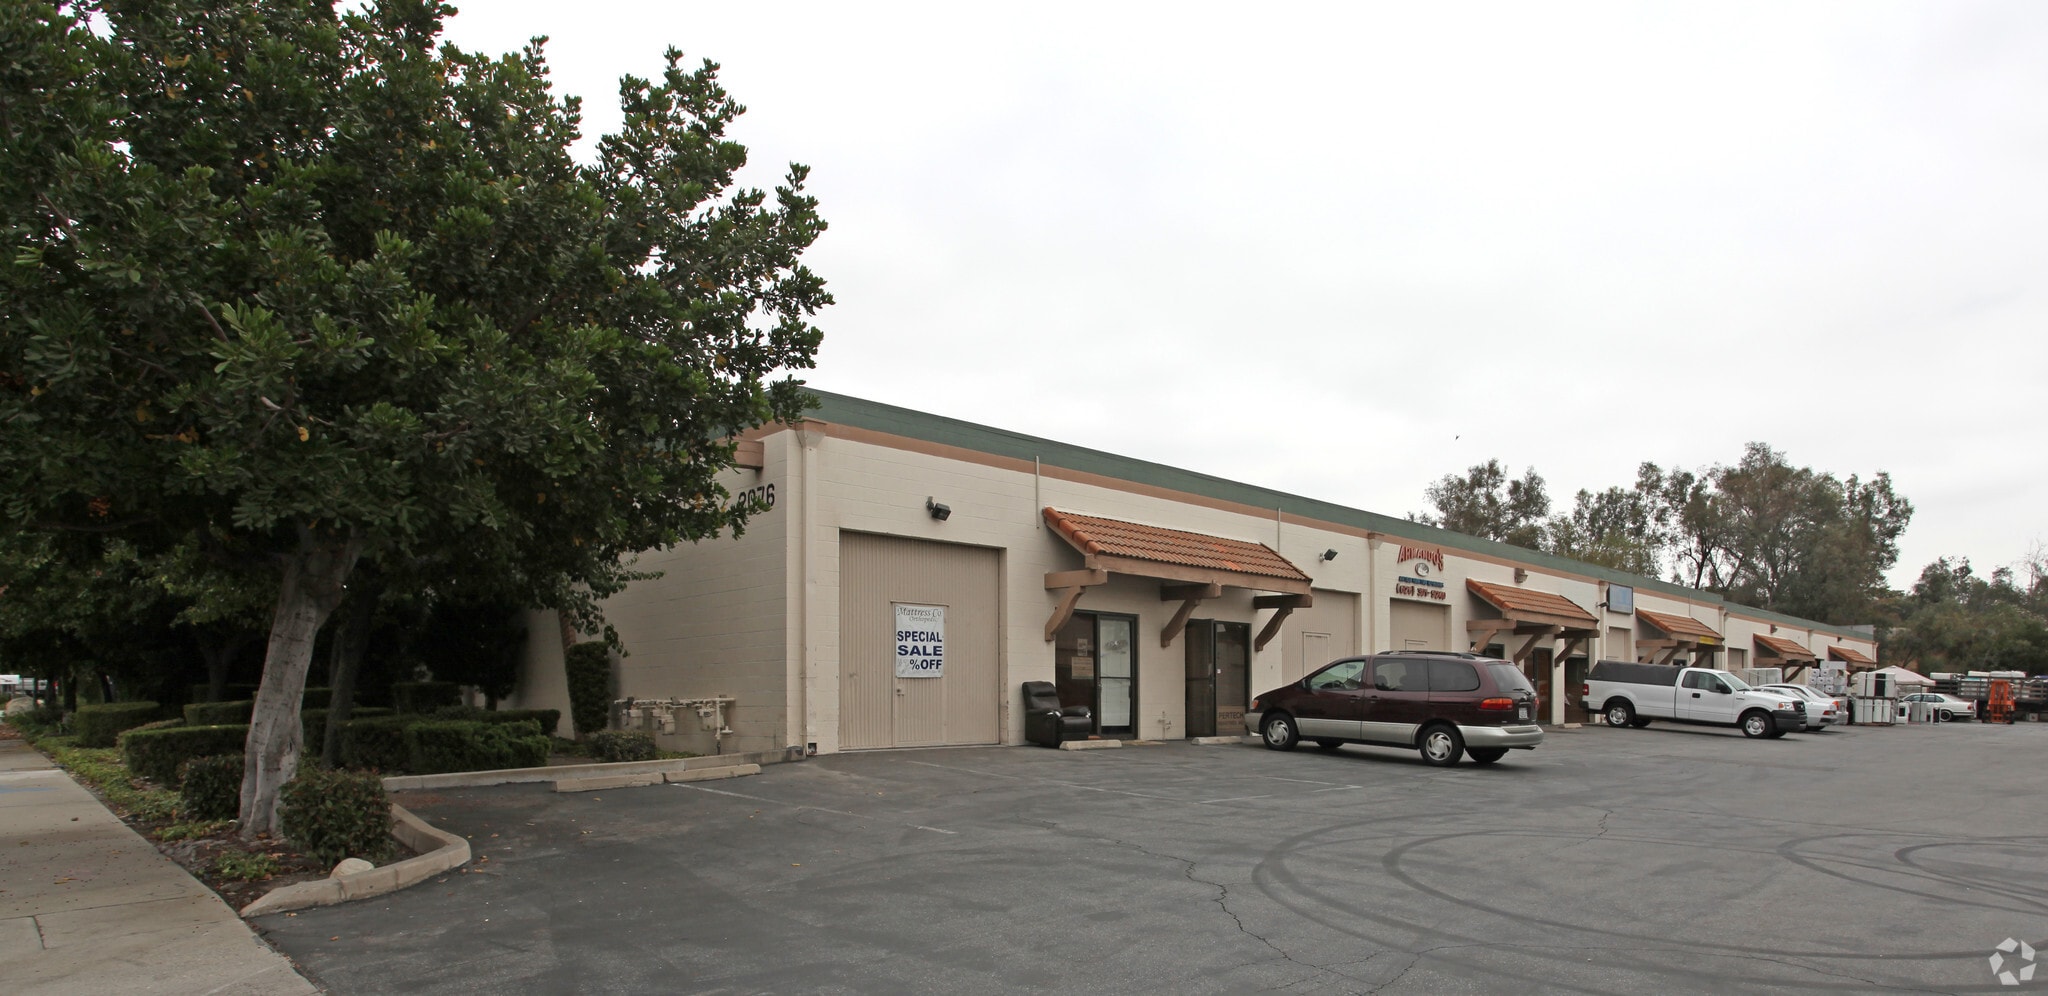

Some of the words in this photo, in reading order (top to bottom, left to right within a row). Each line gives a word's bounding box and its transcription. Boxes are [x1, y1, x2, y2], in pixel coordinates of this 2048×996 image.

[738, 483, 775, 511] 2076
[1397, 545, 1444, 571] ARMANDO'S
[897, 607, 931, 616] Mattress
[897, 630, 943, 643] SPECIAL
[897, 644, 943, 656] SALE
[1218, 711, 1244, 720] PERTECH
